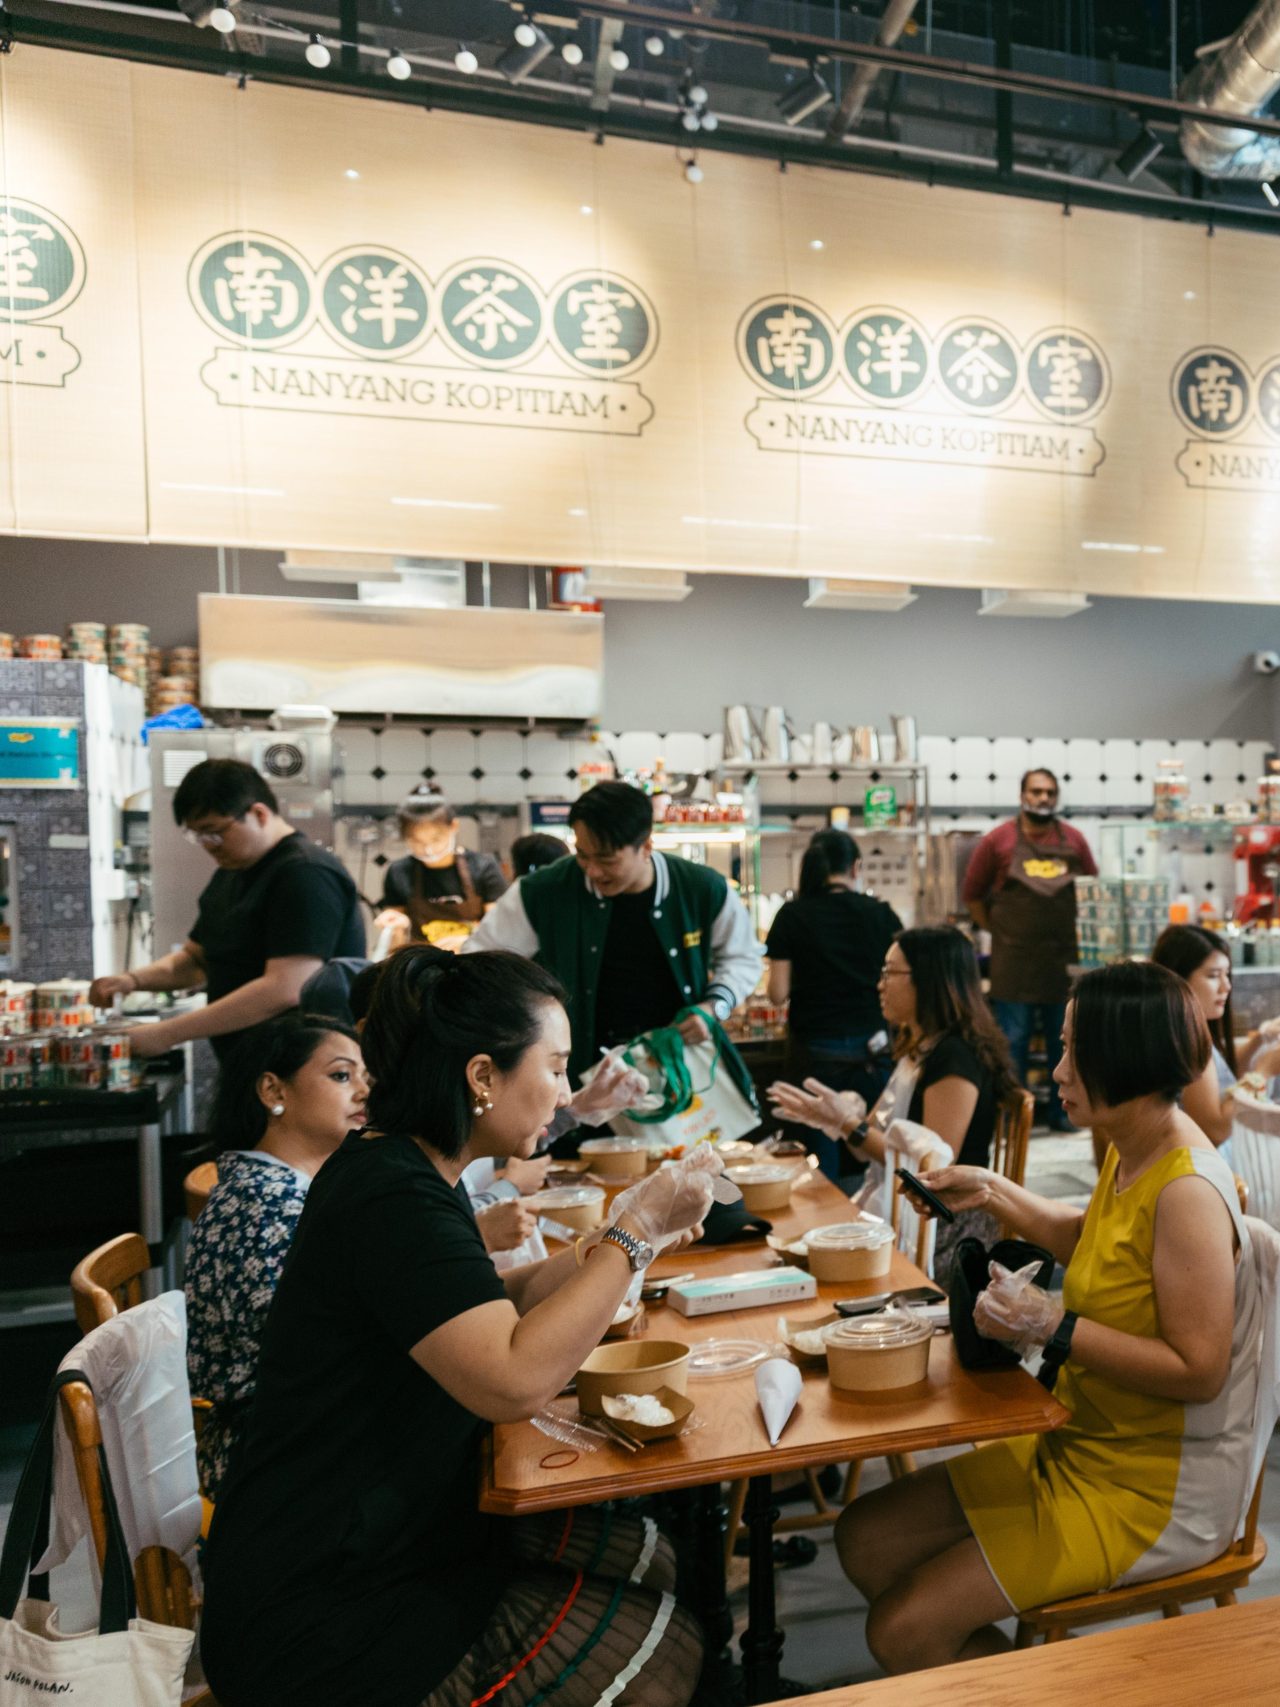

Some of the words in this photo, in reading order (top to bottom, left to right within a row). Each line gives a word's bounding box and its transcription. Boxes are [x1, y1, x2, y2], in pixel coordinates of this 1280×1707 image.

[213, 247, 635, 363] 南洋茶室
[251, 364, 436, 406] NANYANG
[444, 382, 610, 420] KOPITIAM
[756, 310, 1094, 410] 南洋茶室
[784, 413, 933, 449] NANYANG
[940, 427, 1072, 461] KOPITIAM
